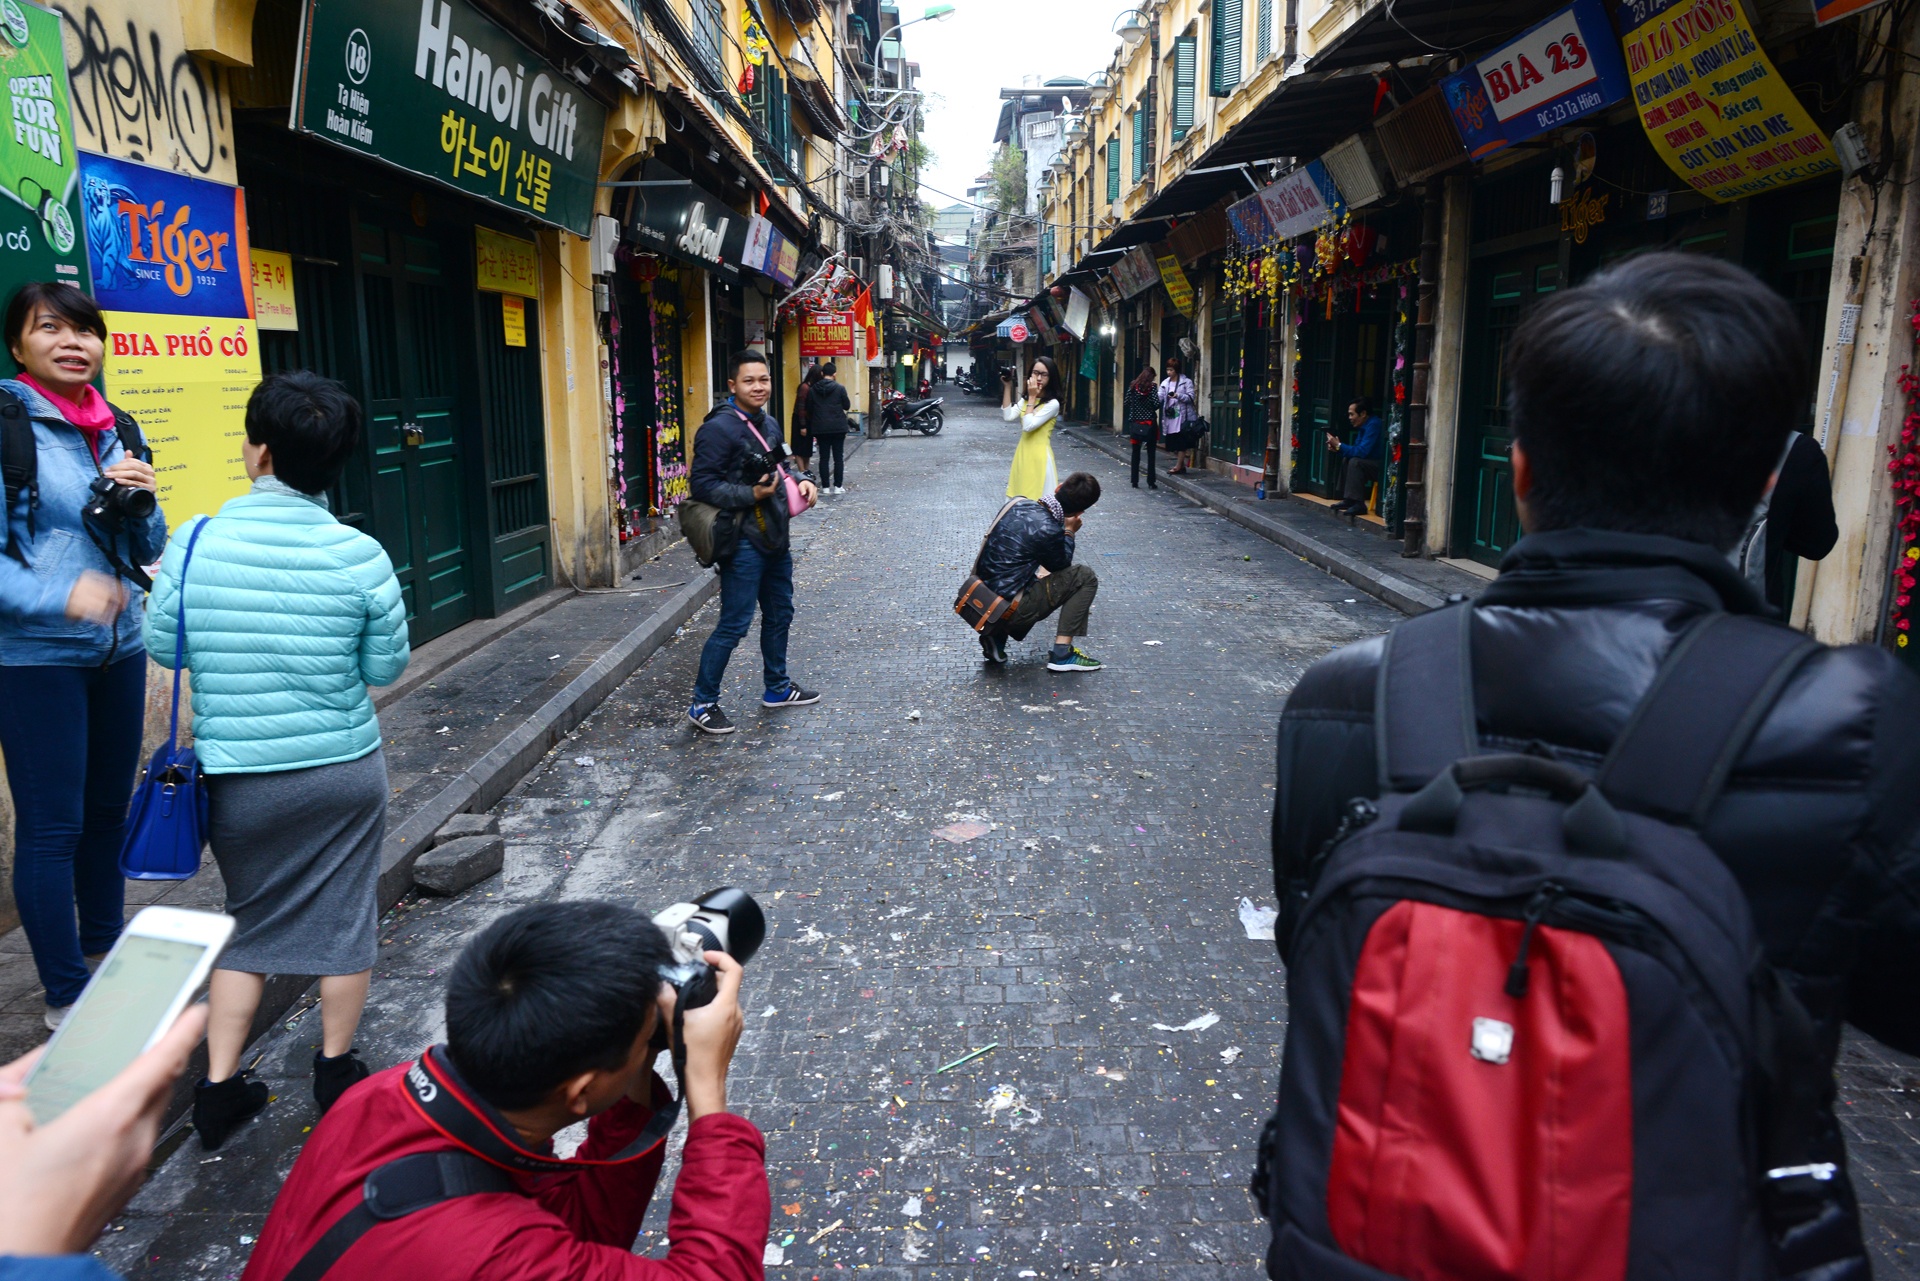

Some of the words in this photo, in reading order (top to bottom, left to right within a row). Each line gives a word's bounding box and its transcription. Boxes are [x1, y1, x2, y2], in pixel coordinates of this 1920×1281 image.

[350, 41, 367, 74] 18
[1484, 53, 1544, 103] BIA
[1545, 33, 1587, 75] 23
[10, 74, 53, 99] OPEN
[415, 0, 525, 131] Hanoi
[528, 73, 577, 162] Gift
[11, 97, 59, 132] FOR
[338, 82, 349, 110] Tạ
[349, 89, 370, 117] Hiện
[1454, 86, 1489, 130] Tiger
[1552, 104, 1567, 121] 23
[14, 121, 63, 166] FUN
[326, 108, 350, 136] Hoàn
[350, 118, 373, 145] Kiếm
[1679, 146, 1710, 170] CÚT
[1705, 137, 1739, 161] LỘN
[1732, 123, 1767, 149] XÀO
[1763, 113, 1794, 138] ME
[441, 109, 511, 196] 하노이
[515, 149, 552, 213] 선물
[1747, 150, 1780, 172] CHIM
[1793, 132, 1826, 156] QUAY
[1560, 186, 1611, 244] Tiger
[1649, 195, 1666, 216] 23
[6, 226, 31, 251] CỔ
[118, 200, 229, 296] Tiger
[136, 268, 161, 281] SINCE
[197, 275, 216, 286] 1932
[111, 332, 160, 357] BIA
[165, 325, 214, 358] PHỐ
[219, 325, 248, 358] CỔ
[803, 326, 826, 341] LITTLE
[828, 326, 850, 341] HANOI
